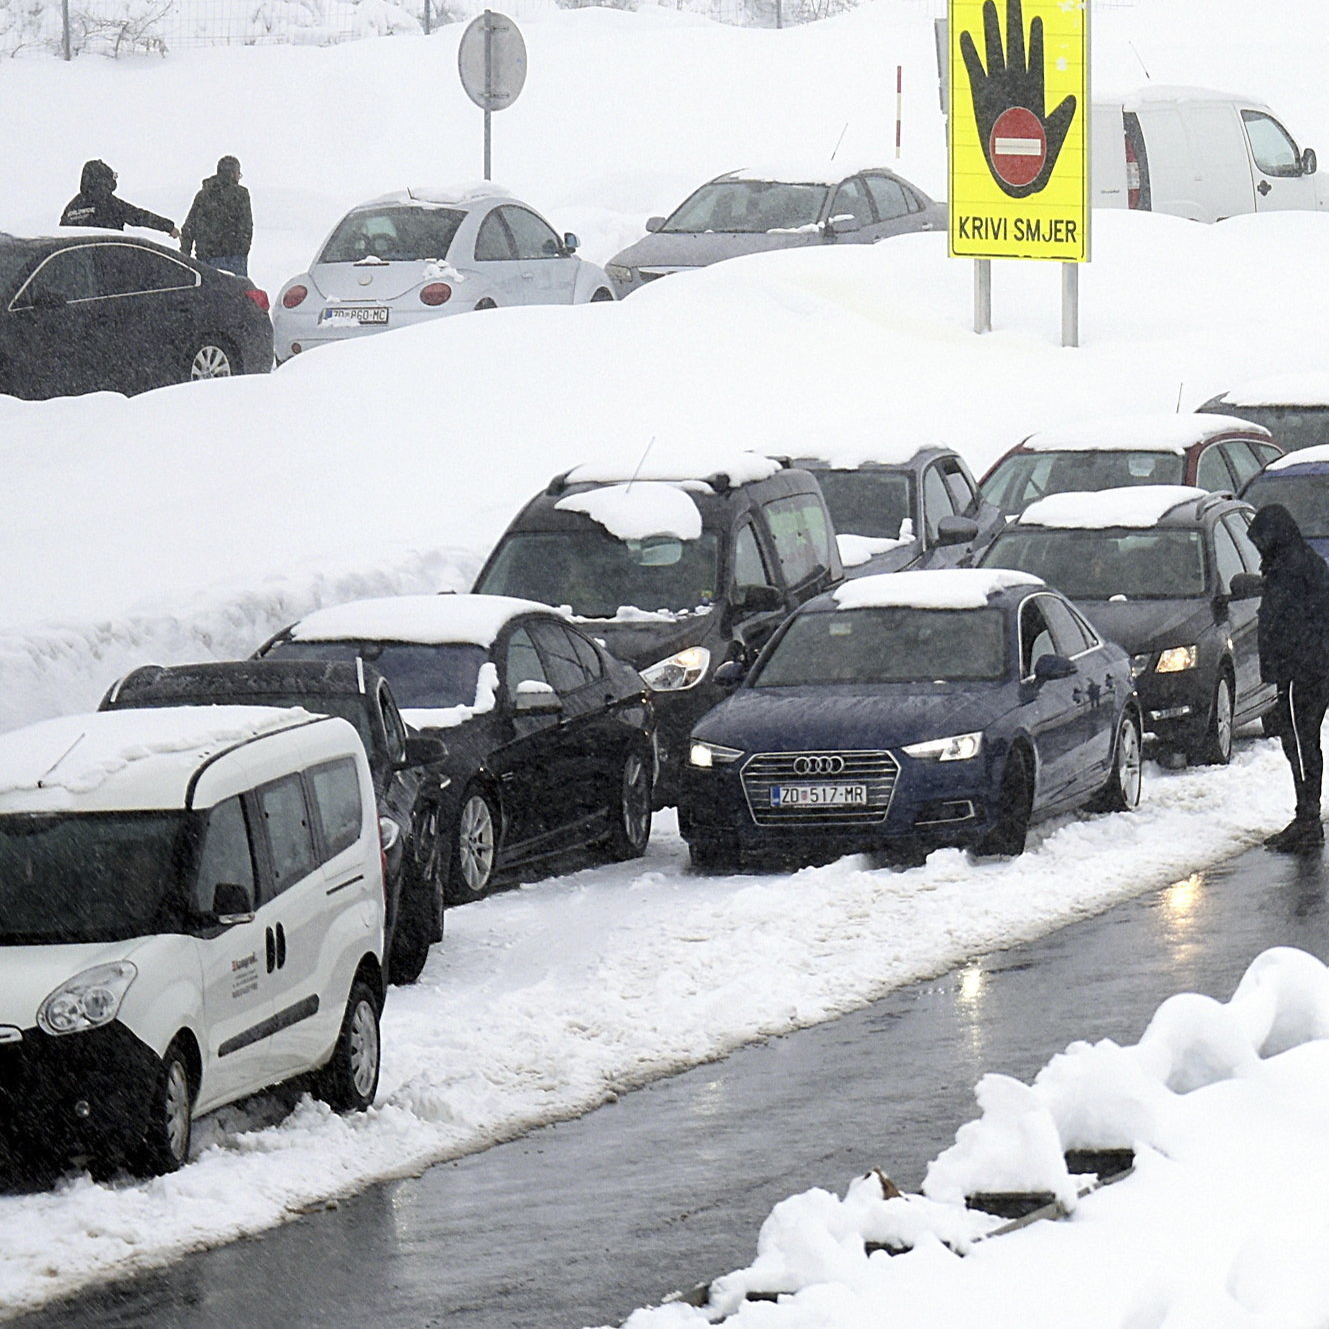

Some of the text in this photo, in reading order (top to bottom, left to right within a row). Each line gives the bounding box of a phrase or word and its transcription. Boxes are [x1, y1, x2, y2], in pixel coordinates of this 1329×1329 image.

[959, 216, 1077, 243] KRIVI SMJER
[781, 786, 863, 804] ZD 517-MR
